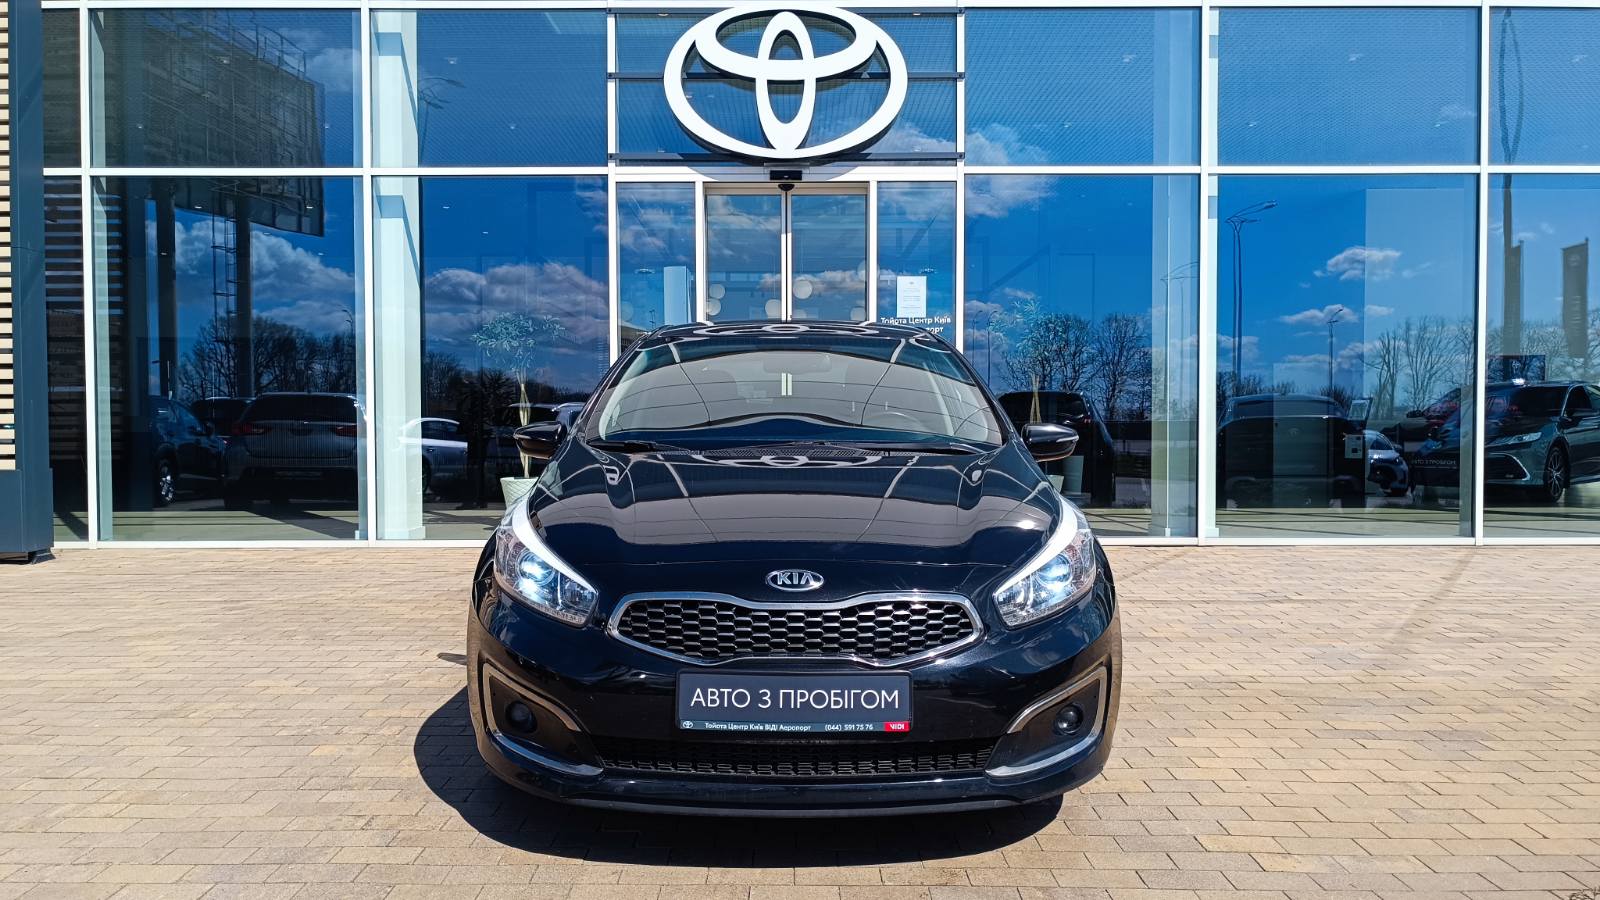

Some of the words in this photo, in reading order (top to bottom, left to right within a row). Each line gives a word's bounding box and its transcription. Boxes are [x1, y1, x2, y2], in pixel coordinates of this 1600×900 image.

[880, 317, 907, 325] Тойота
[908, 316, 933, 325] Центр
[934, 315, 951, 324] Київ
[777, 572, 814, 585] KIA
[690, 688, 750, 708] АВТО
[758, 689, 772, 708] З
[779, 689, 899, 709] ПРОБІГОМ
[728, 723, 748, 731] Центр
[779, 724, 811, 732] Аеропорт
[824, 723, 842, 731] (044)
[844, 723, 855, 731] 591
